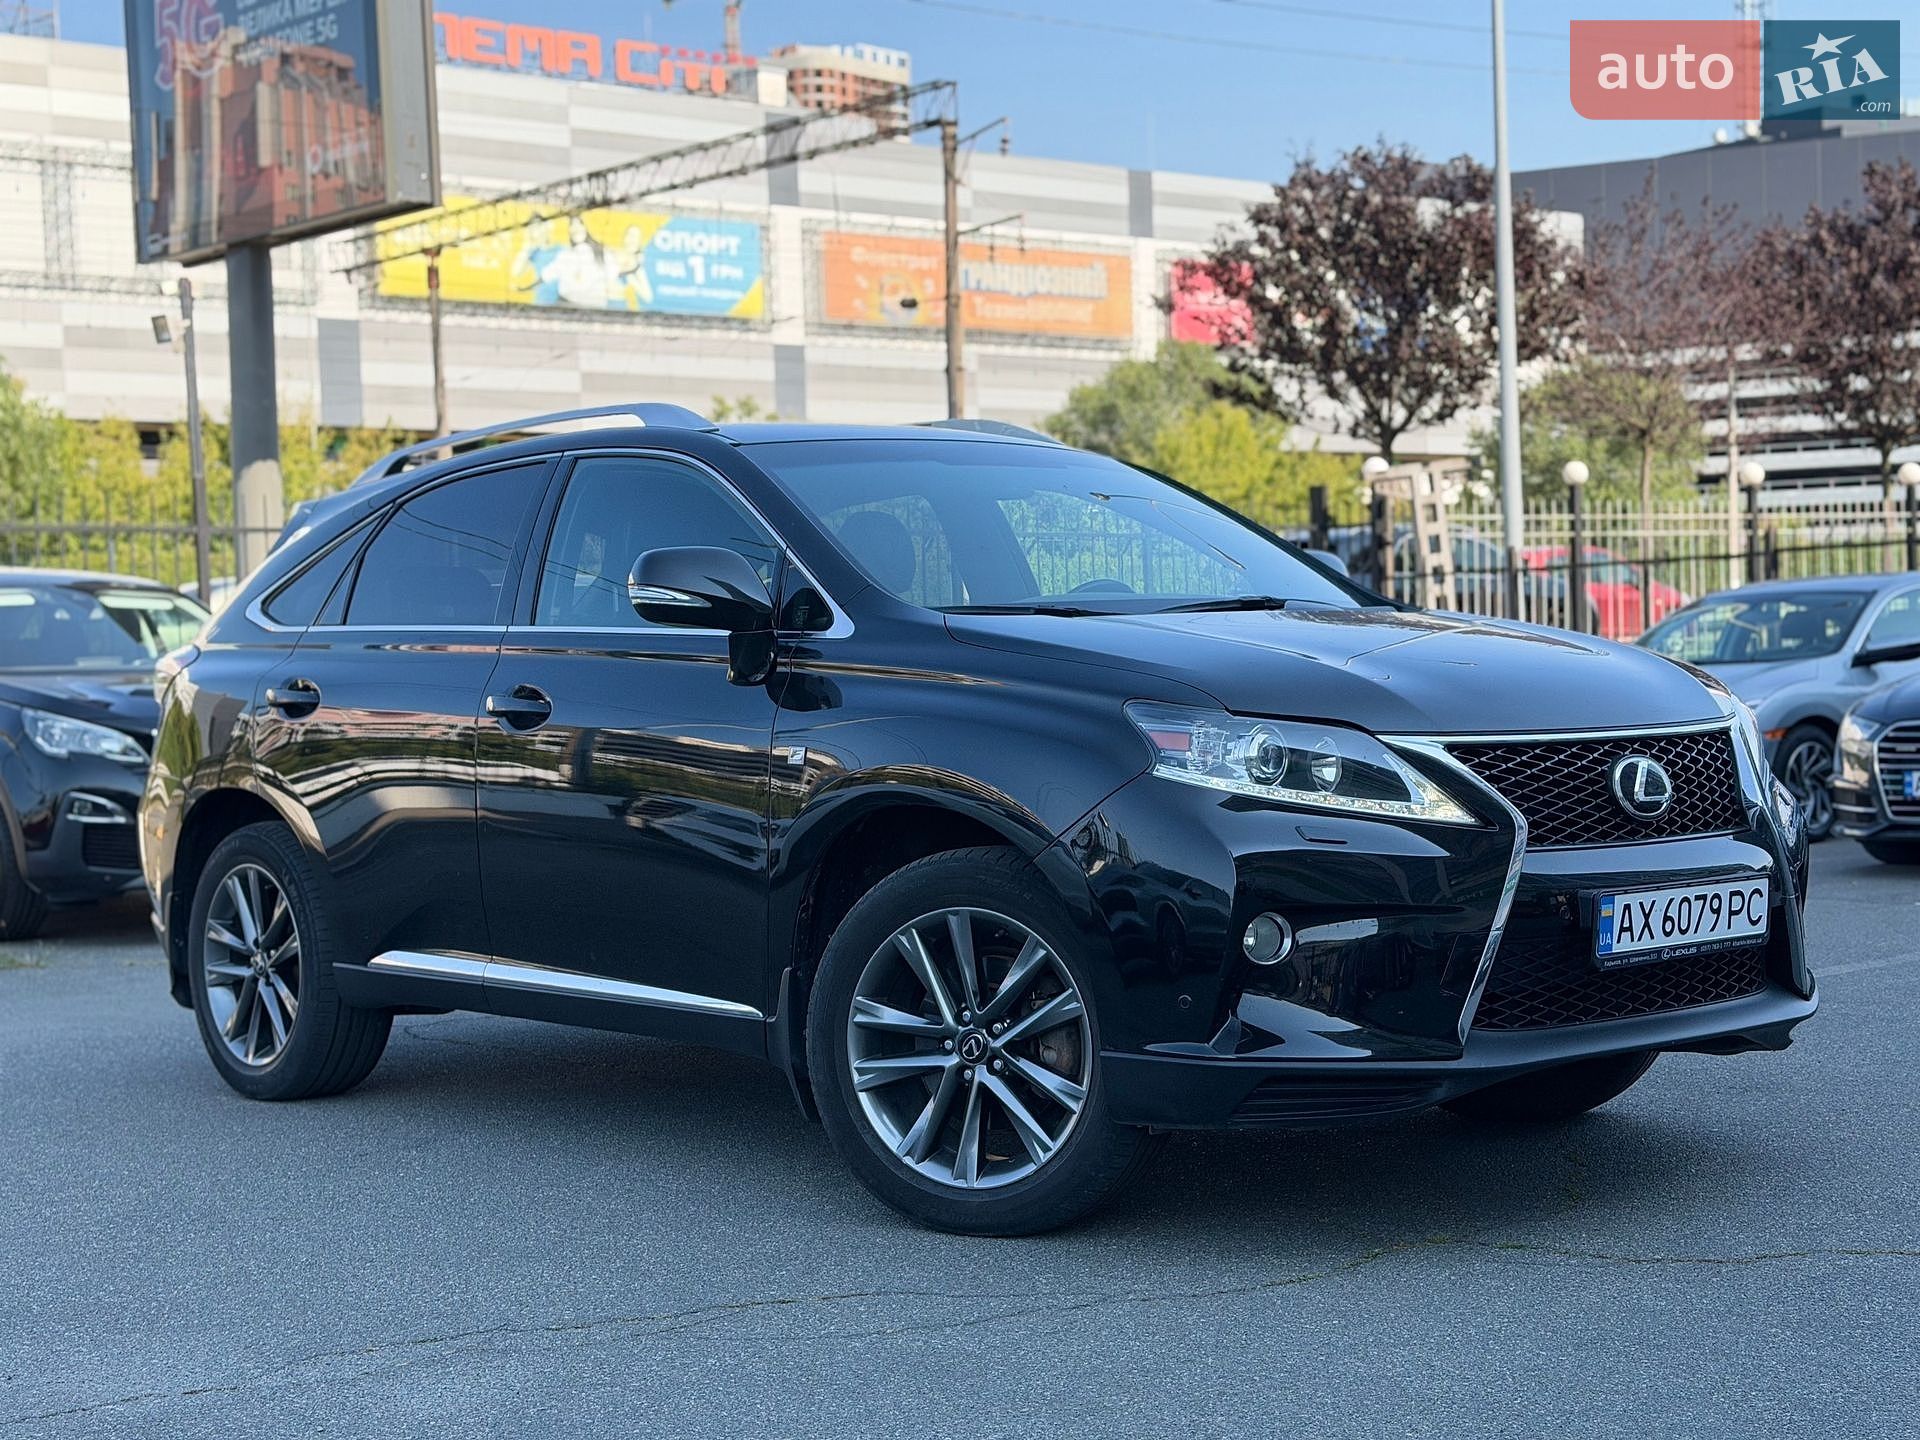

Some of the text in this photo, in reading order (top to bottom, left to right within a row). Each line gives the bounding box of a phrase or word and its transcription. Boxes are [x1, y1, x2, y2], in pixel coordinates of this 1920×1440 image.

[654, 230, 741, 257] СПОРТ
[688, 255, 706, 286] 1
[1616, 887, 1764, 944] AX 6079 PC
[1600, 932, 1612, 946] UA
[1671, 946, 1698, 957] LEXUS
